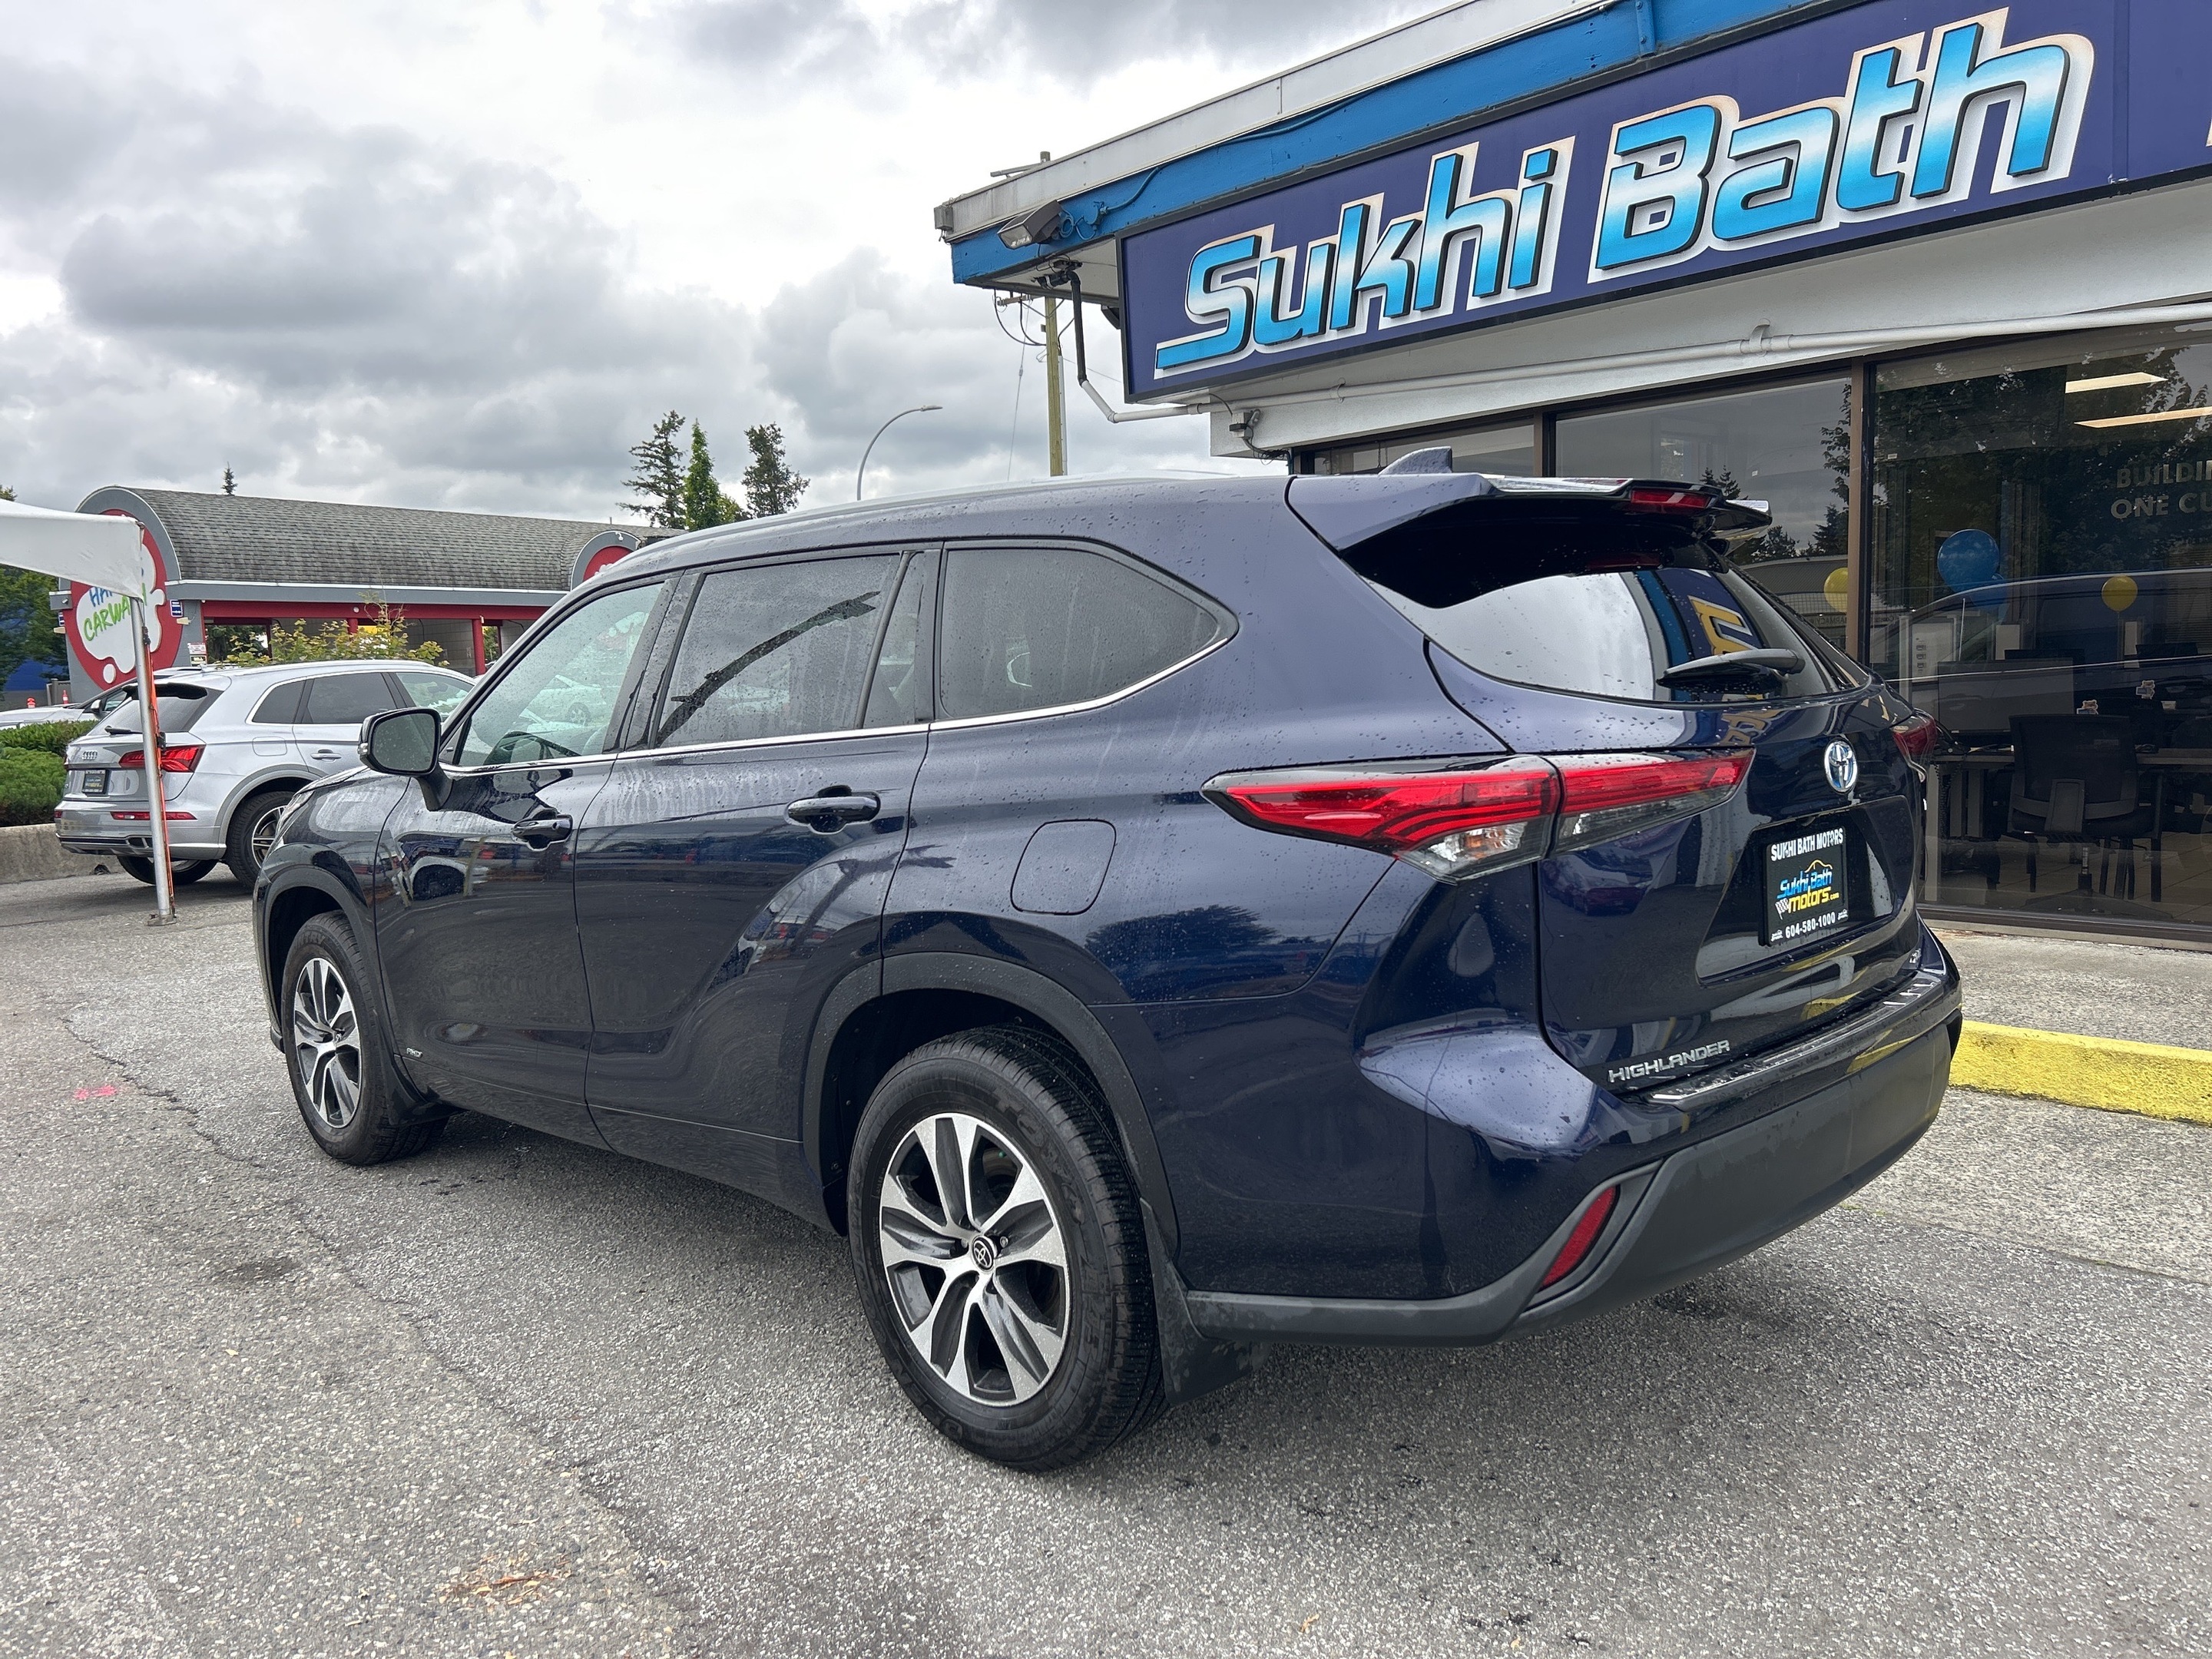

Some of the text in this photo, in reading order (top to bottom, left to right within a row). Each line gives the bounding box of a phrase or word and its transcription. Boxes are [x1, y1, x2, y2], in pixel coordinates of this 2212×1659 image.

[1155, 8, 2095, 377] Sukhi Bath
[2111, 495, 2169, 519] ONE
[84, 582, 147, 641] CARWA
[1771, 828, 1843, 861] SUKHI BATH MOTORS
[1777, 869, 1833, 899] Sukhi Bath
[1785, 912, 1836, 939] 604-580-1000
[1608, 1039, 1730, 1083] HIGHLANDER
